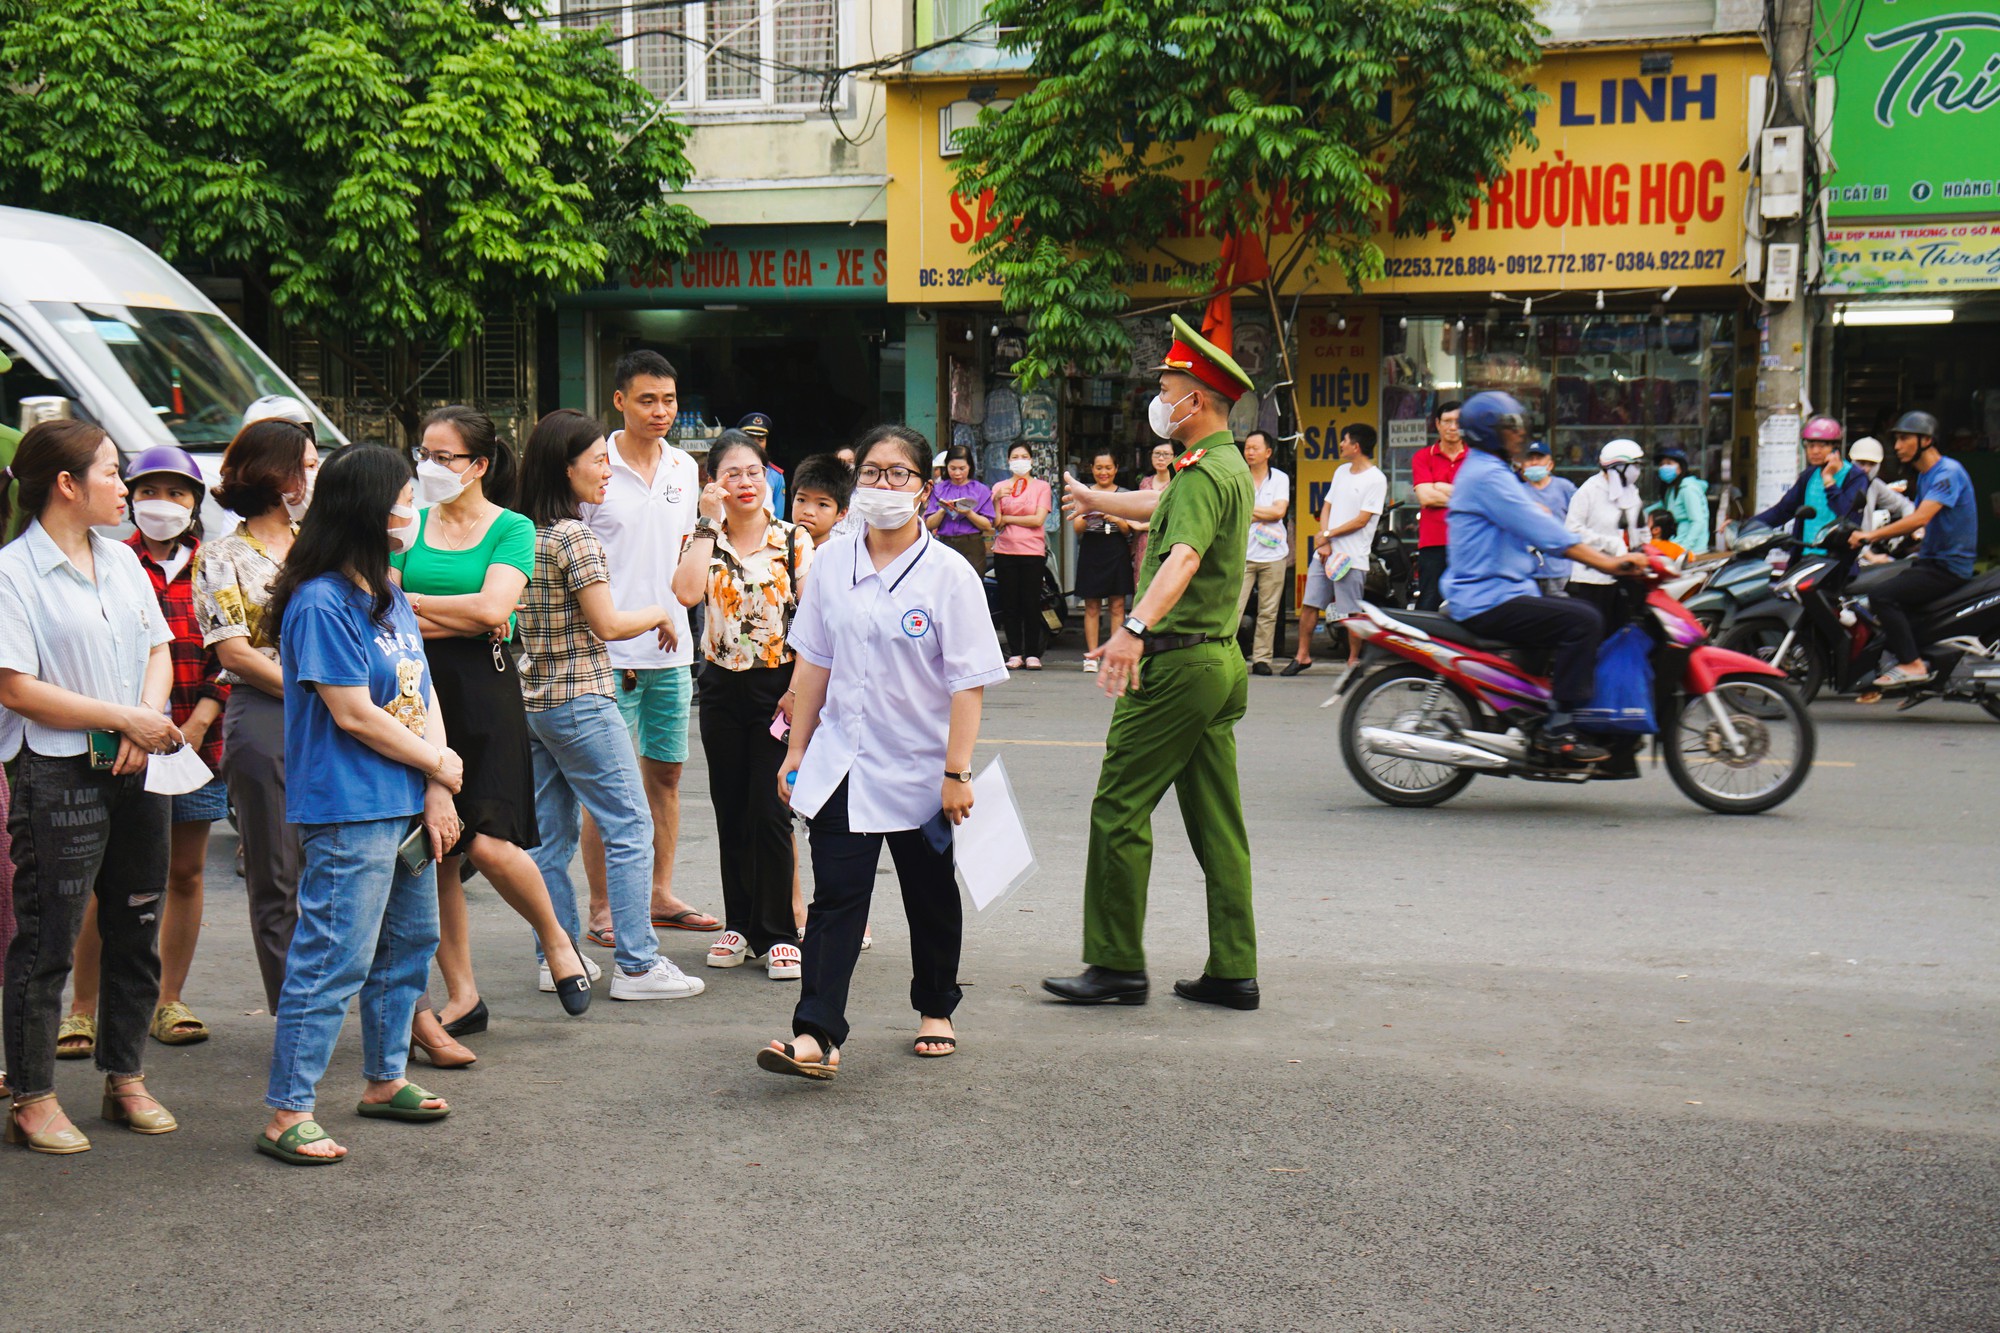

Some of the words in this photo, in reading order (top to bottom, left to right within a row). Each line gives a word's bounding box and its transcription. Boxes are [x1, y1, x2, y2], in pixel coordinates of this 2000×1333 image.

[1865, 12, 2000, 127] Thi
[1560, 74, 1717, 127] LINH
[1640, 158, 1726, 235] HỌC
[1843, 184, 1868, 200] CÁT
[1873, 186, 1888, 200] BI
[1943, 178, 1992, 197] HOÀNG
[1868, 229, 1896, 240] KHAI
[748, 250, 776, 287] XE
[783, 250, 812, 287] GA
[835, 249, 864, 287] XE
[873, 249, 887, 287] S
[919, 268, 943, 287] ĐC:
[1506, 253, 1607, 275] 0912.772.187
[1615, 249, 1726, 272] 0384.922.027
[1870, 247, 1914, 263] TRÀ
[1310, 366, 1370, 413] HIỆU
[374, 632, 421, 657] BEAR
[75, 787, 99, 804] AM
[58, 878, 84, 895] MY
